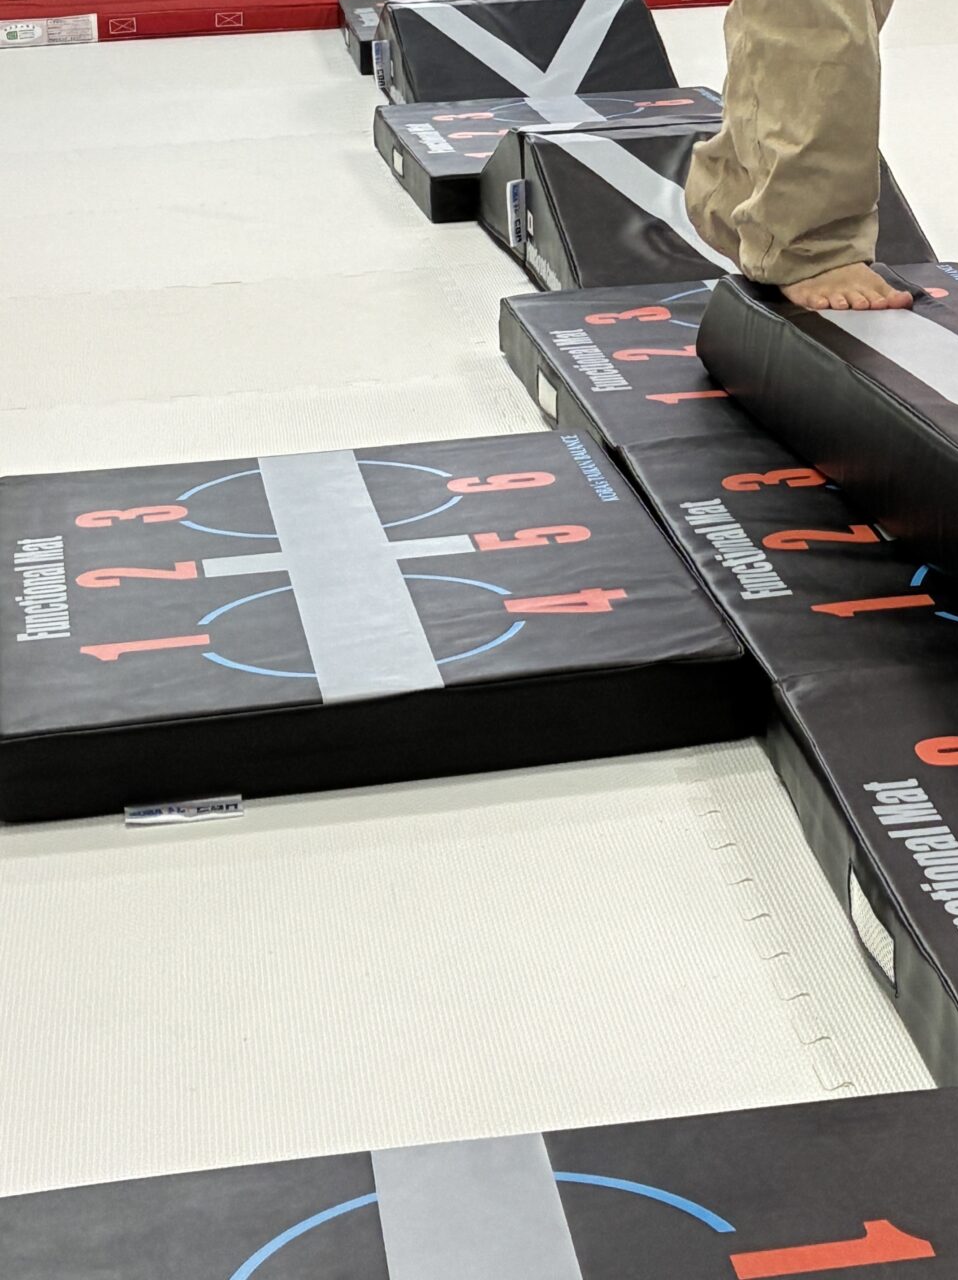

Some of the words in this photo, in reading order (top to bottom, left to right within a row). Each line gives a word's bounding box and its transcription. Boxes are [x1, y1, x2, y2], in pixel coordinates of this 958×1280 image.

[679, 498, 737, 526] Mat
[14, 535, 64, 564] Mat
[694, 522, 793, 600] Functional
[15, 562, 70, 642] Functional
[863, 778, 942, 826] Mat
[729, 1218, 936, 1280] 1
